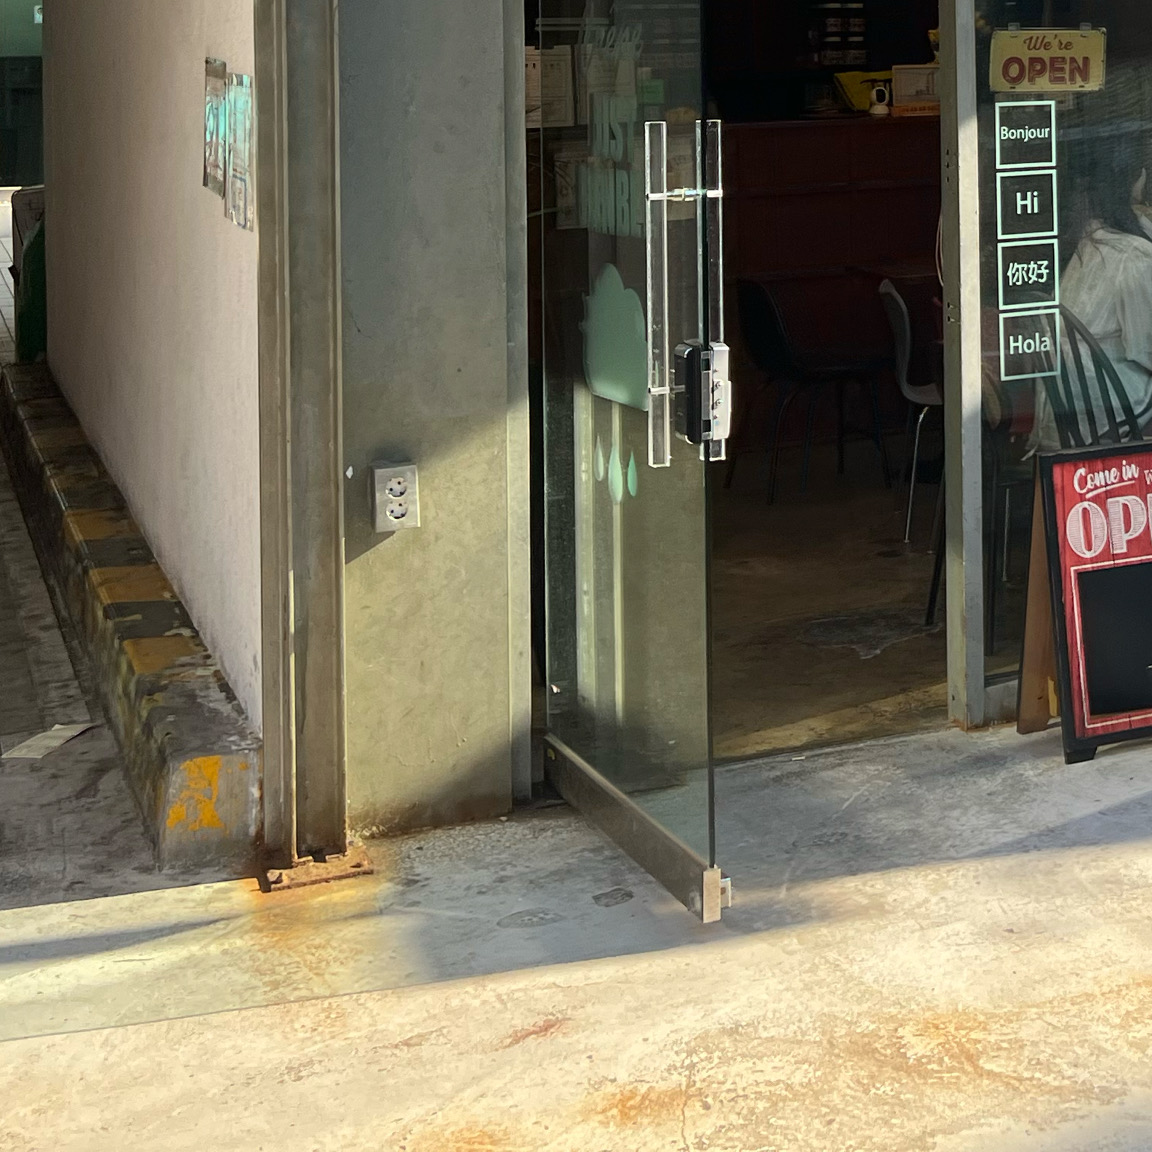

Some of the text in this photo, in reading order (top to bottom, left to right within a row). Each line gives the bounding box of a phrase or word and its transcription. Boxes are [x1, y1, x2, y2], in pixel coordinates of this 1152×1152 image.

[1022, 35, 1074, 52] We're
[1001, 55, 1091, 86] OPEN
[1000, 125, 1051, 143] Bonjour
[1016, 191, 1039, 215] Hi
[1007, 260, 1050, 286] 你好
[1009, 334, 1051, 355] Hola
[1073, 466, 1120, 494] Come
[1121, 459, 1140, 481] in
